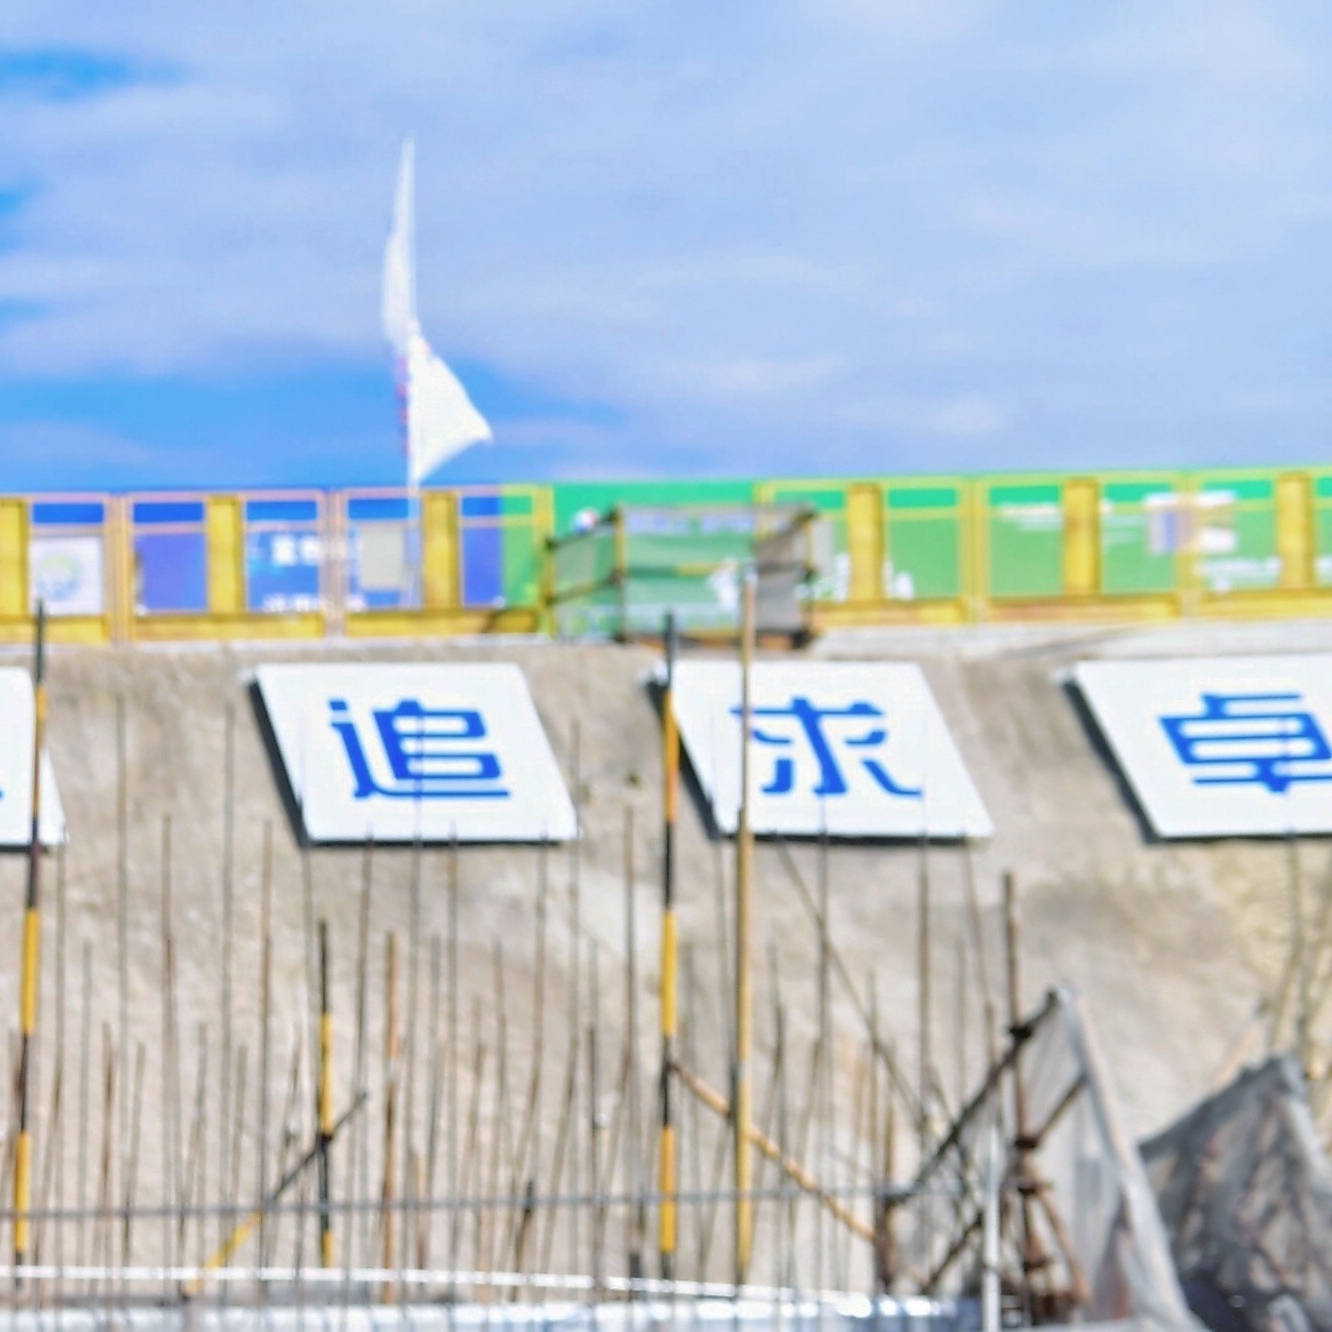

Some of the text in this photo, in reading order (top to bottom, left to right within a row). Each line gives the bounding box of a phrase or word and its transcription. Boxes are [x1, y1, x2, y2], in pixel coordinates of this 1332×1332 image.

[328, 697, 510, 799] 追
[731, 696, 924, 797] 求
[1158, 694, 1332, 793] 卓
